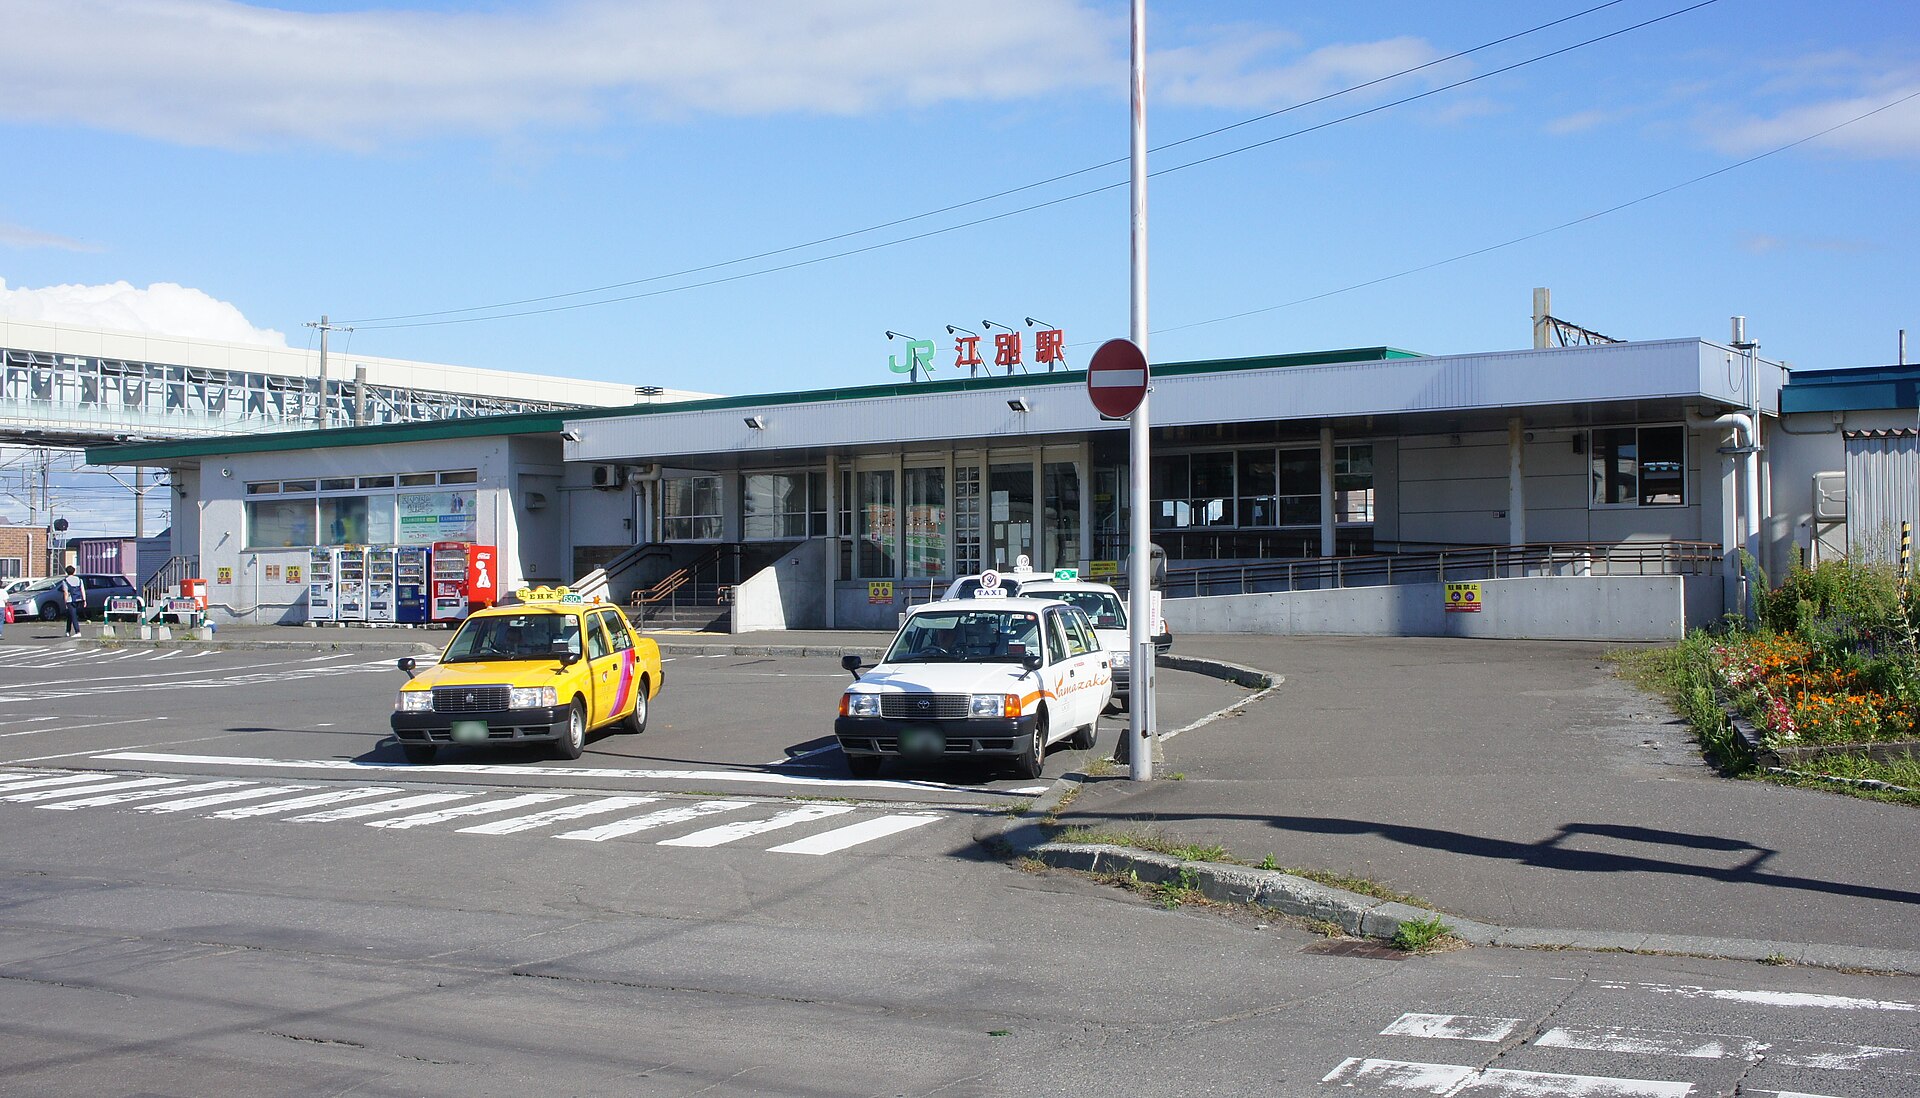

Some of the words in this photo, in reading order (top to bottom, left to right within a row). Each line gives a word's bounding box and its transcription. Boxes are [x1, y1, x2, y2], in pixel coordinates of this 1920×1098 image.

[889, 340, 935, 374] JR
[955, 329, 1064, 369] 江別駅
[1053, 672, 1110, 698] Yamazaki
